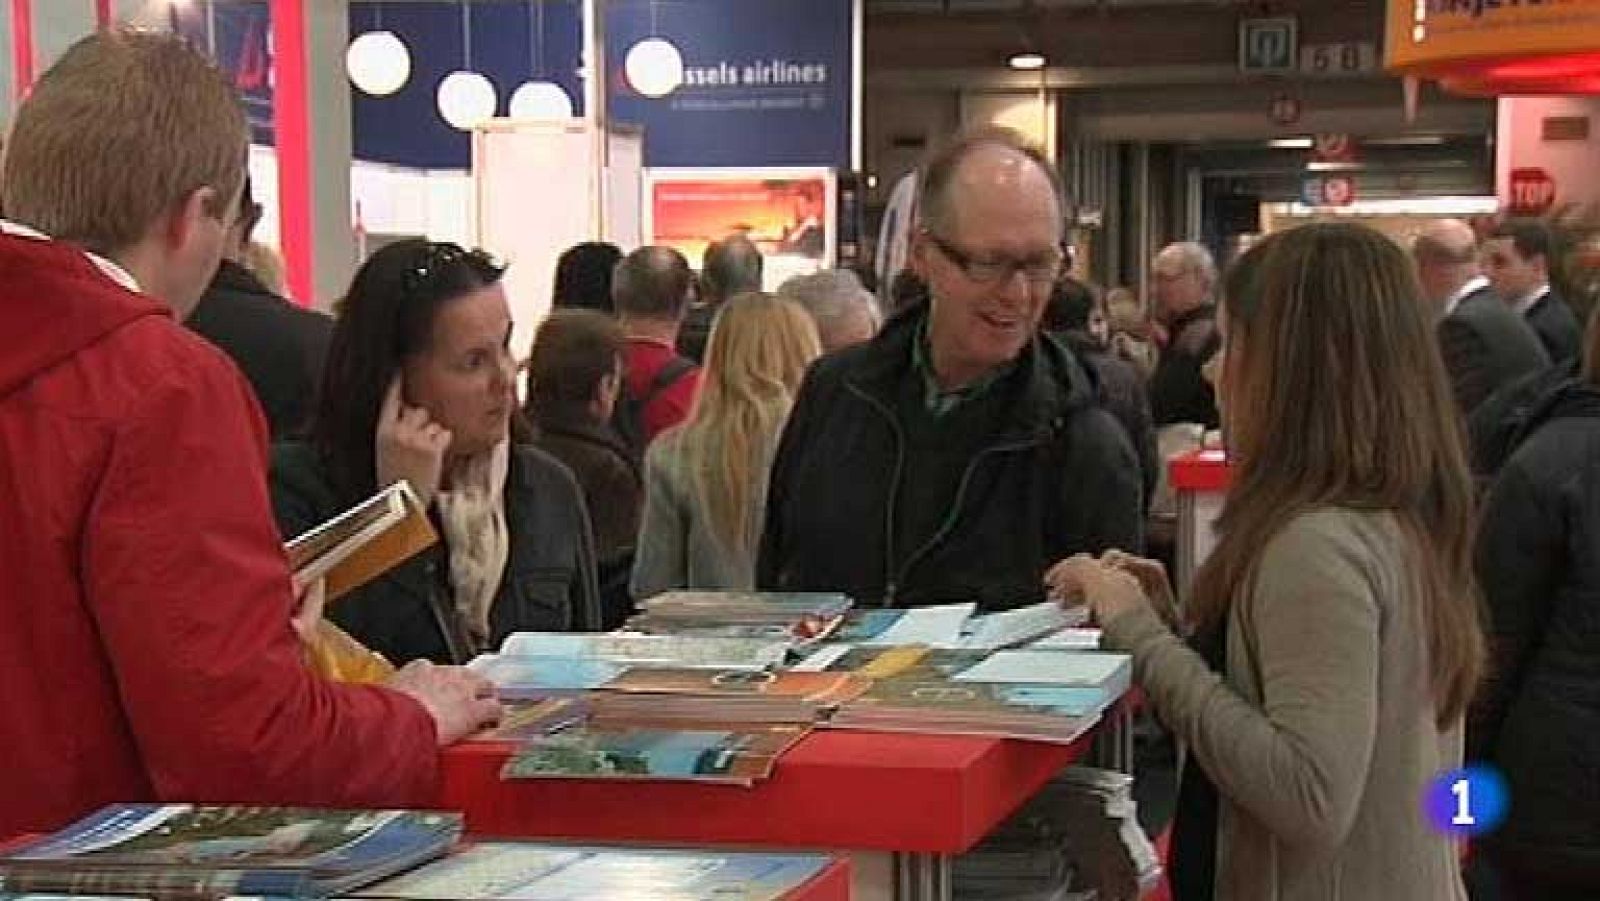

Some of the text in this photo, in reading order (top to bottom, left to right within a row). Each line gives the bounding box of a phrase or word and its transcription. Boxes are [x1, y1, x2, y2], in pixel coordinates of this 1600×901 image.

[684, 60, 826, 85] ssels airlines
[1512, 182, 1554, 209] TOP
